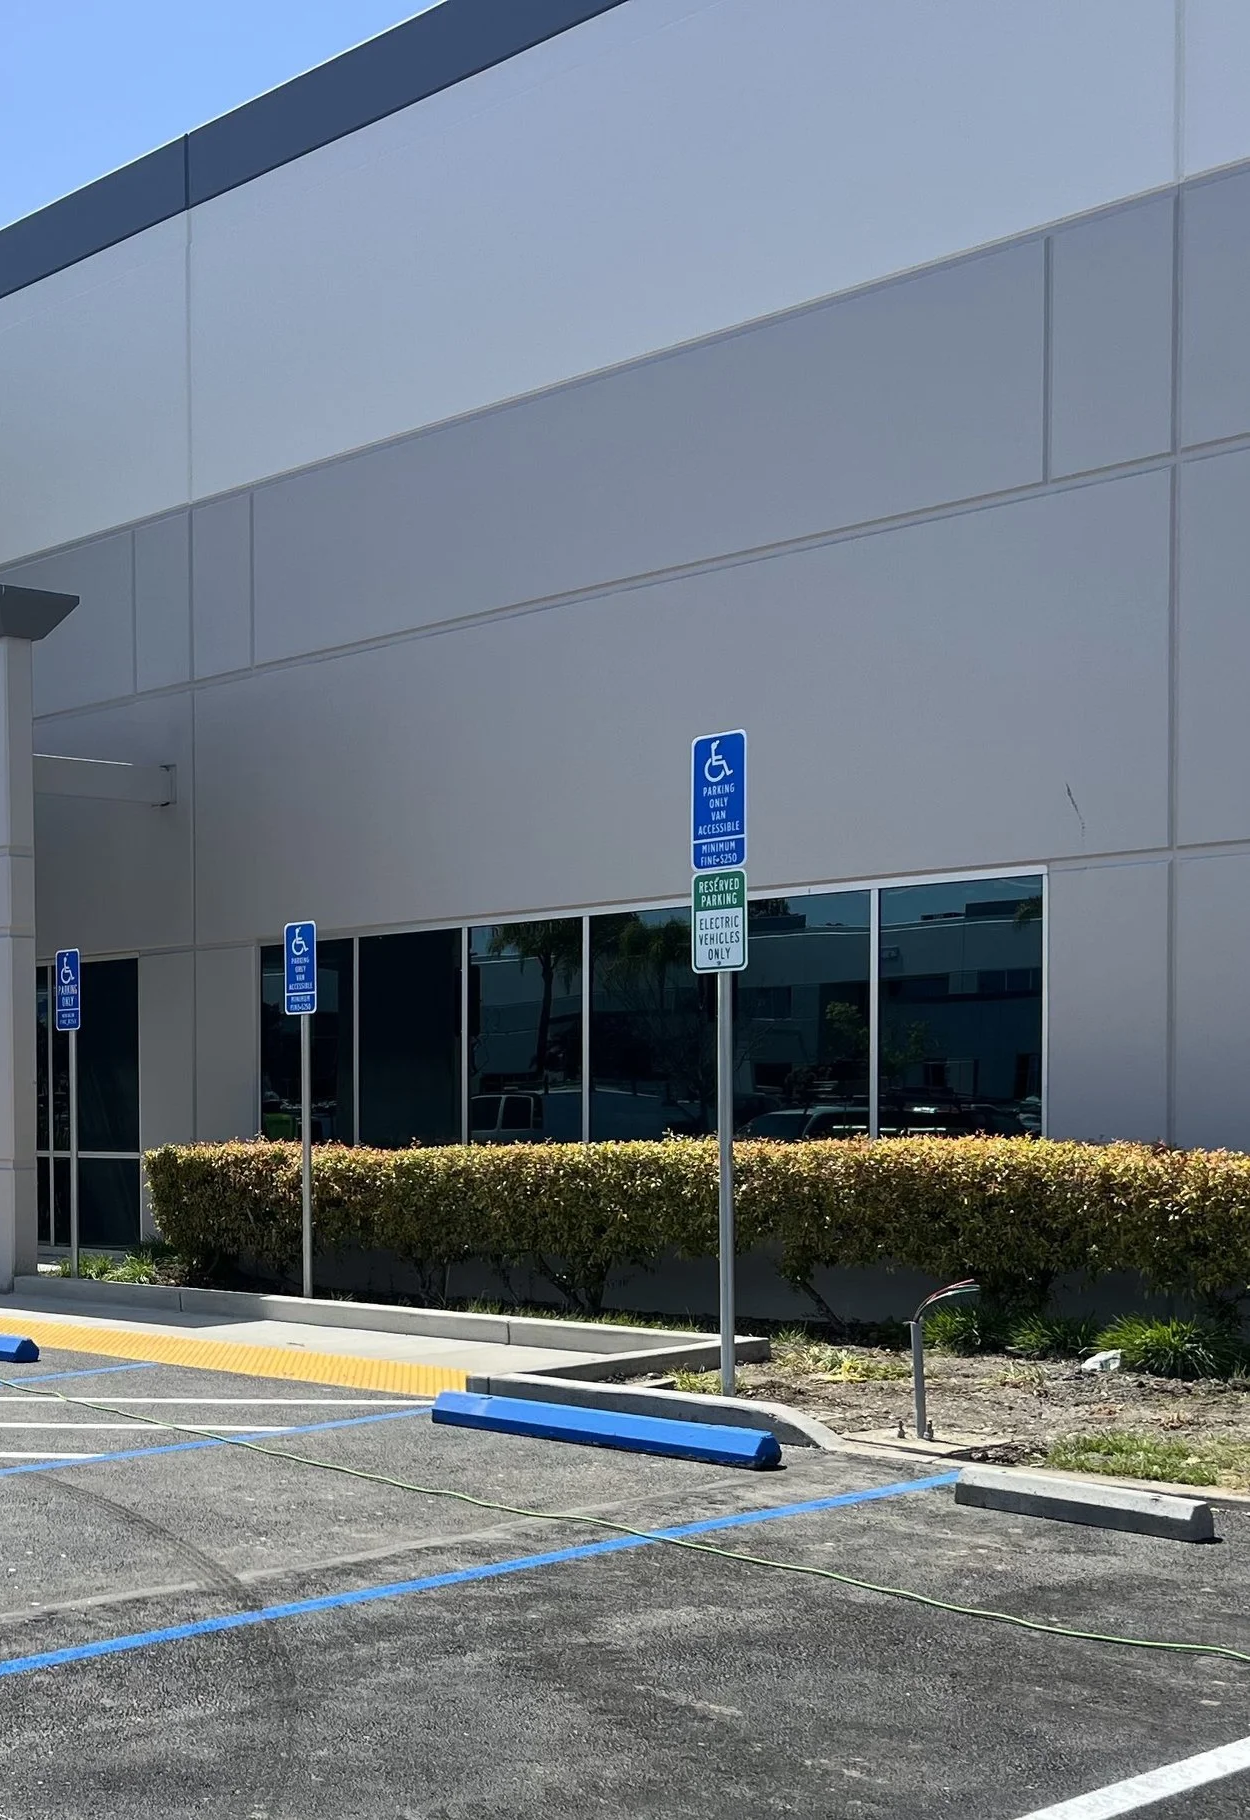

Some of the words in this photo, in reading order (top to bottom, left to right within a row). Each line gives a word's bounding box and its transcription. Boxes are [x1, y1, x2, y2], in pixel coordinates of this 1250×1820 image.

[703, 783, 735, 797] PARKING
[709, 797, 728, 808] ONLY
[711, 810, 726, 821] VAN
[697, 820, 740, 835] ACCESSIBLE
[701, 841, 736, 854] MINIMUM
[698, 878, 740, 894] RESERVED
[701, 892, 737, 907] PARKING
[699, 915, 739, 930] ELECTRIC
[698, 930, 740, 946] VEHICLES
[707, 947, 731, 961] ONLY
[58, 984, 77, 995] PARKING
